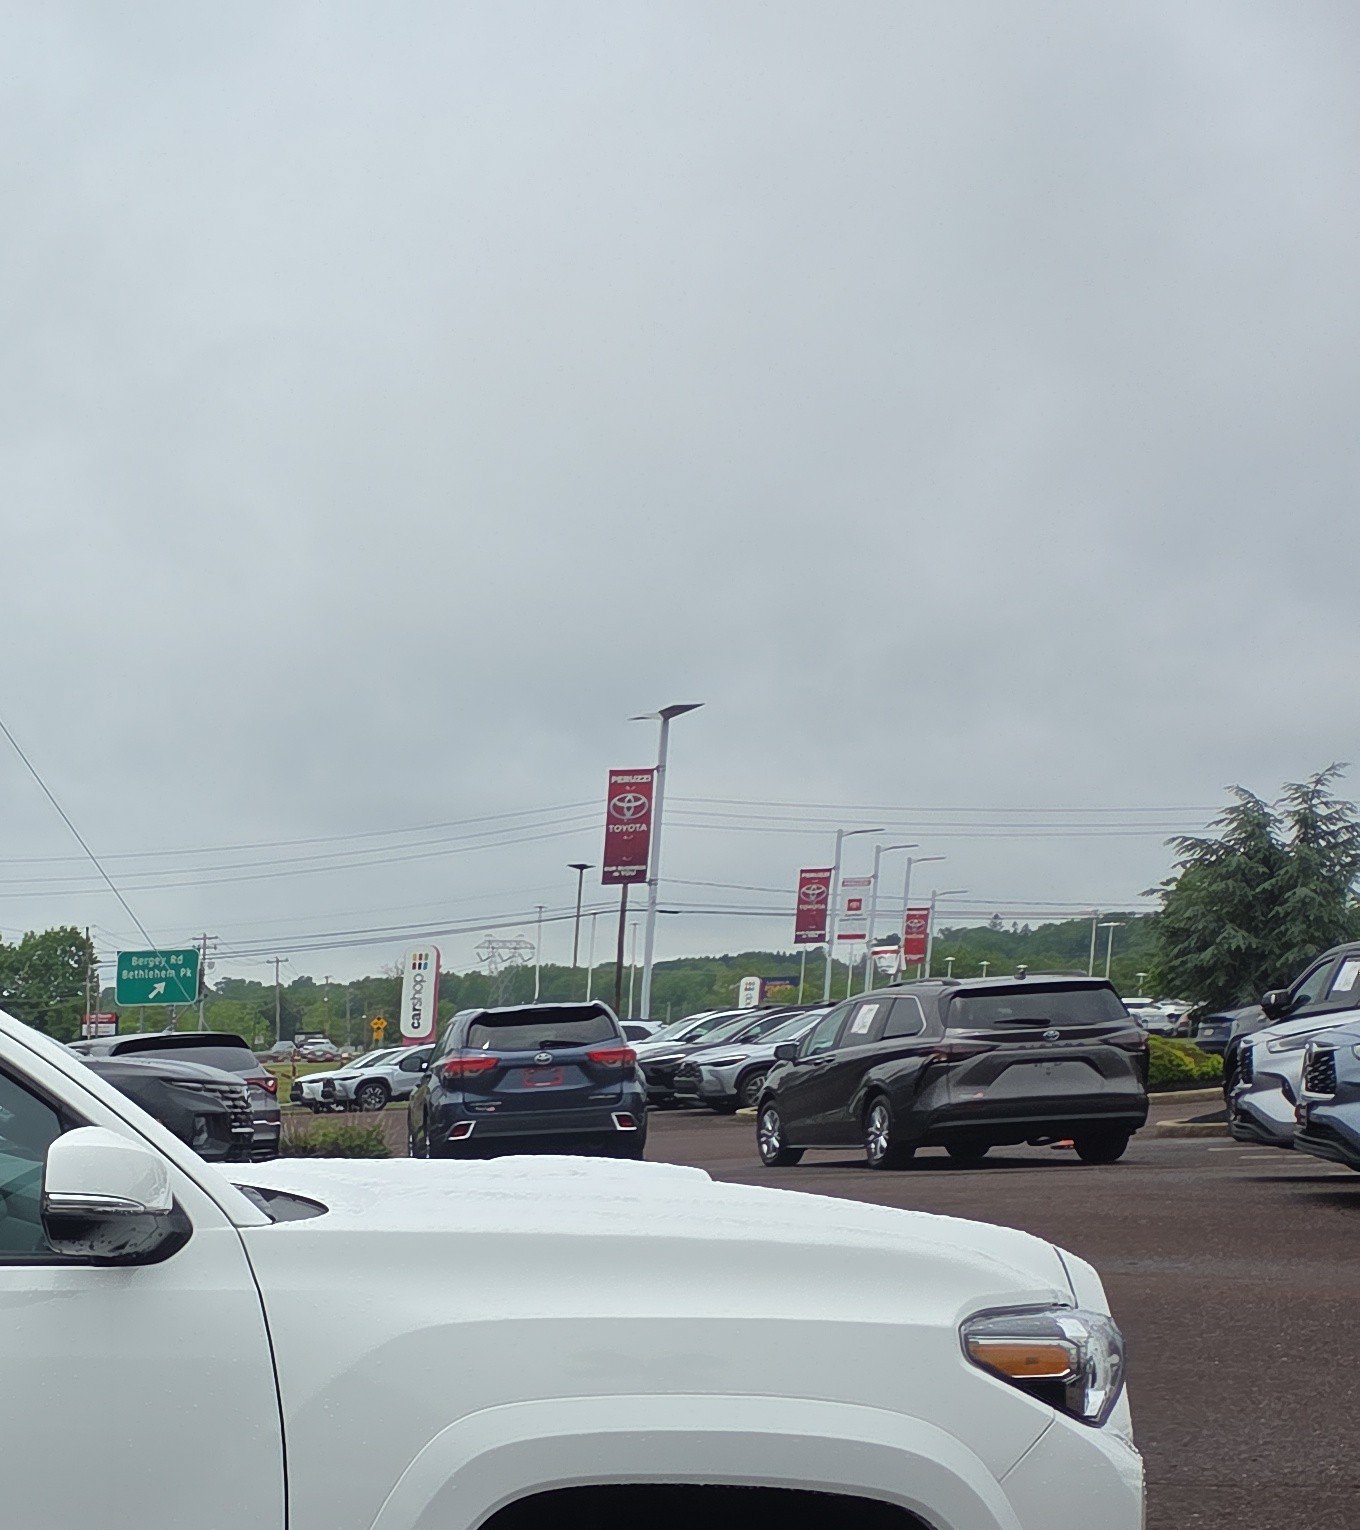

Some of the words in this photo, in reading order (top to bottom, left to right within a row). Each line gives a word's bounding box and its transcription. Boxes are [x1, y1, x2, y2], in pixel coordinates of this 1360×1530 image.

[608, 823, 647, 833] TOYOTA
[131, 956, 167, 967] Bergey
[169, 955, 184, 965] Rd
[121, 968, 175, 980] Bethlehem
[180, 967, 192, 978] Pk
[410, 973, 427, 1030] carshop
